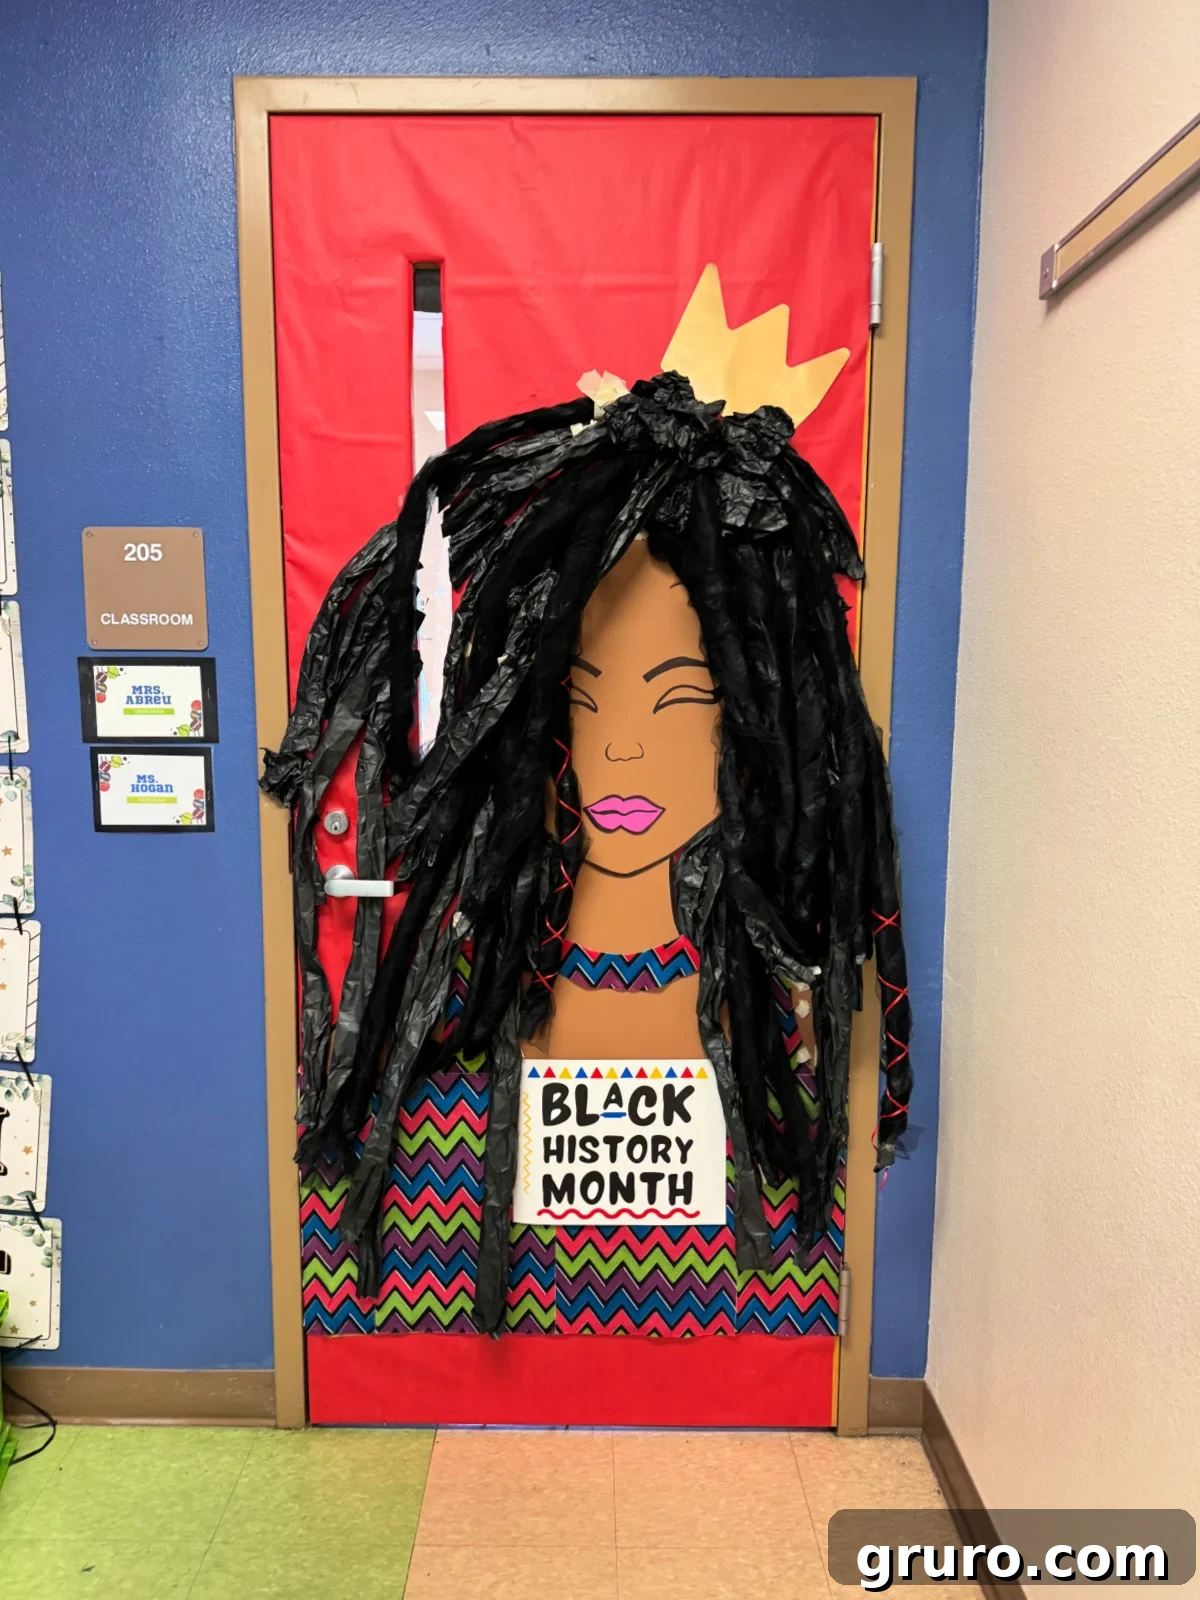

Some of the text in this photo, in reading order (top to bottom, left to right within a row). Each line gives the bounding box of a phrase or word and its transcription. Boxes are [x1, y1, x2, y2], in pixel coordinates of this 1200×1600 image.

[123, 543, 163, 562] 205
[100, 612, 194, 626] CLASSROOM
[131, 685, 165, 695] MRS.
[136, 774, 159, 784] MS.
[542, 1082, 695, 1127] BLACK
[543, 1134, 694, 1165] HISTORY
[542, 1170, 694, 1208] MONTH
